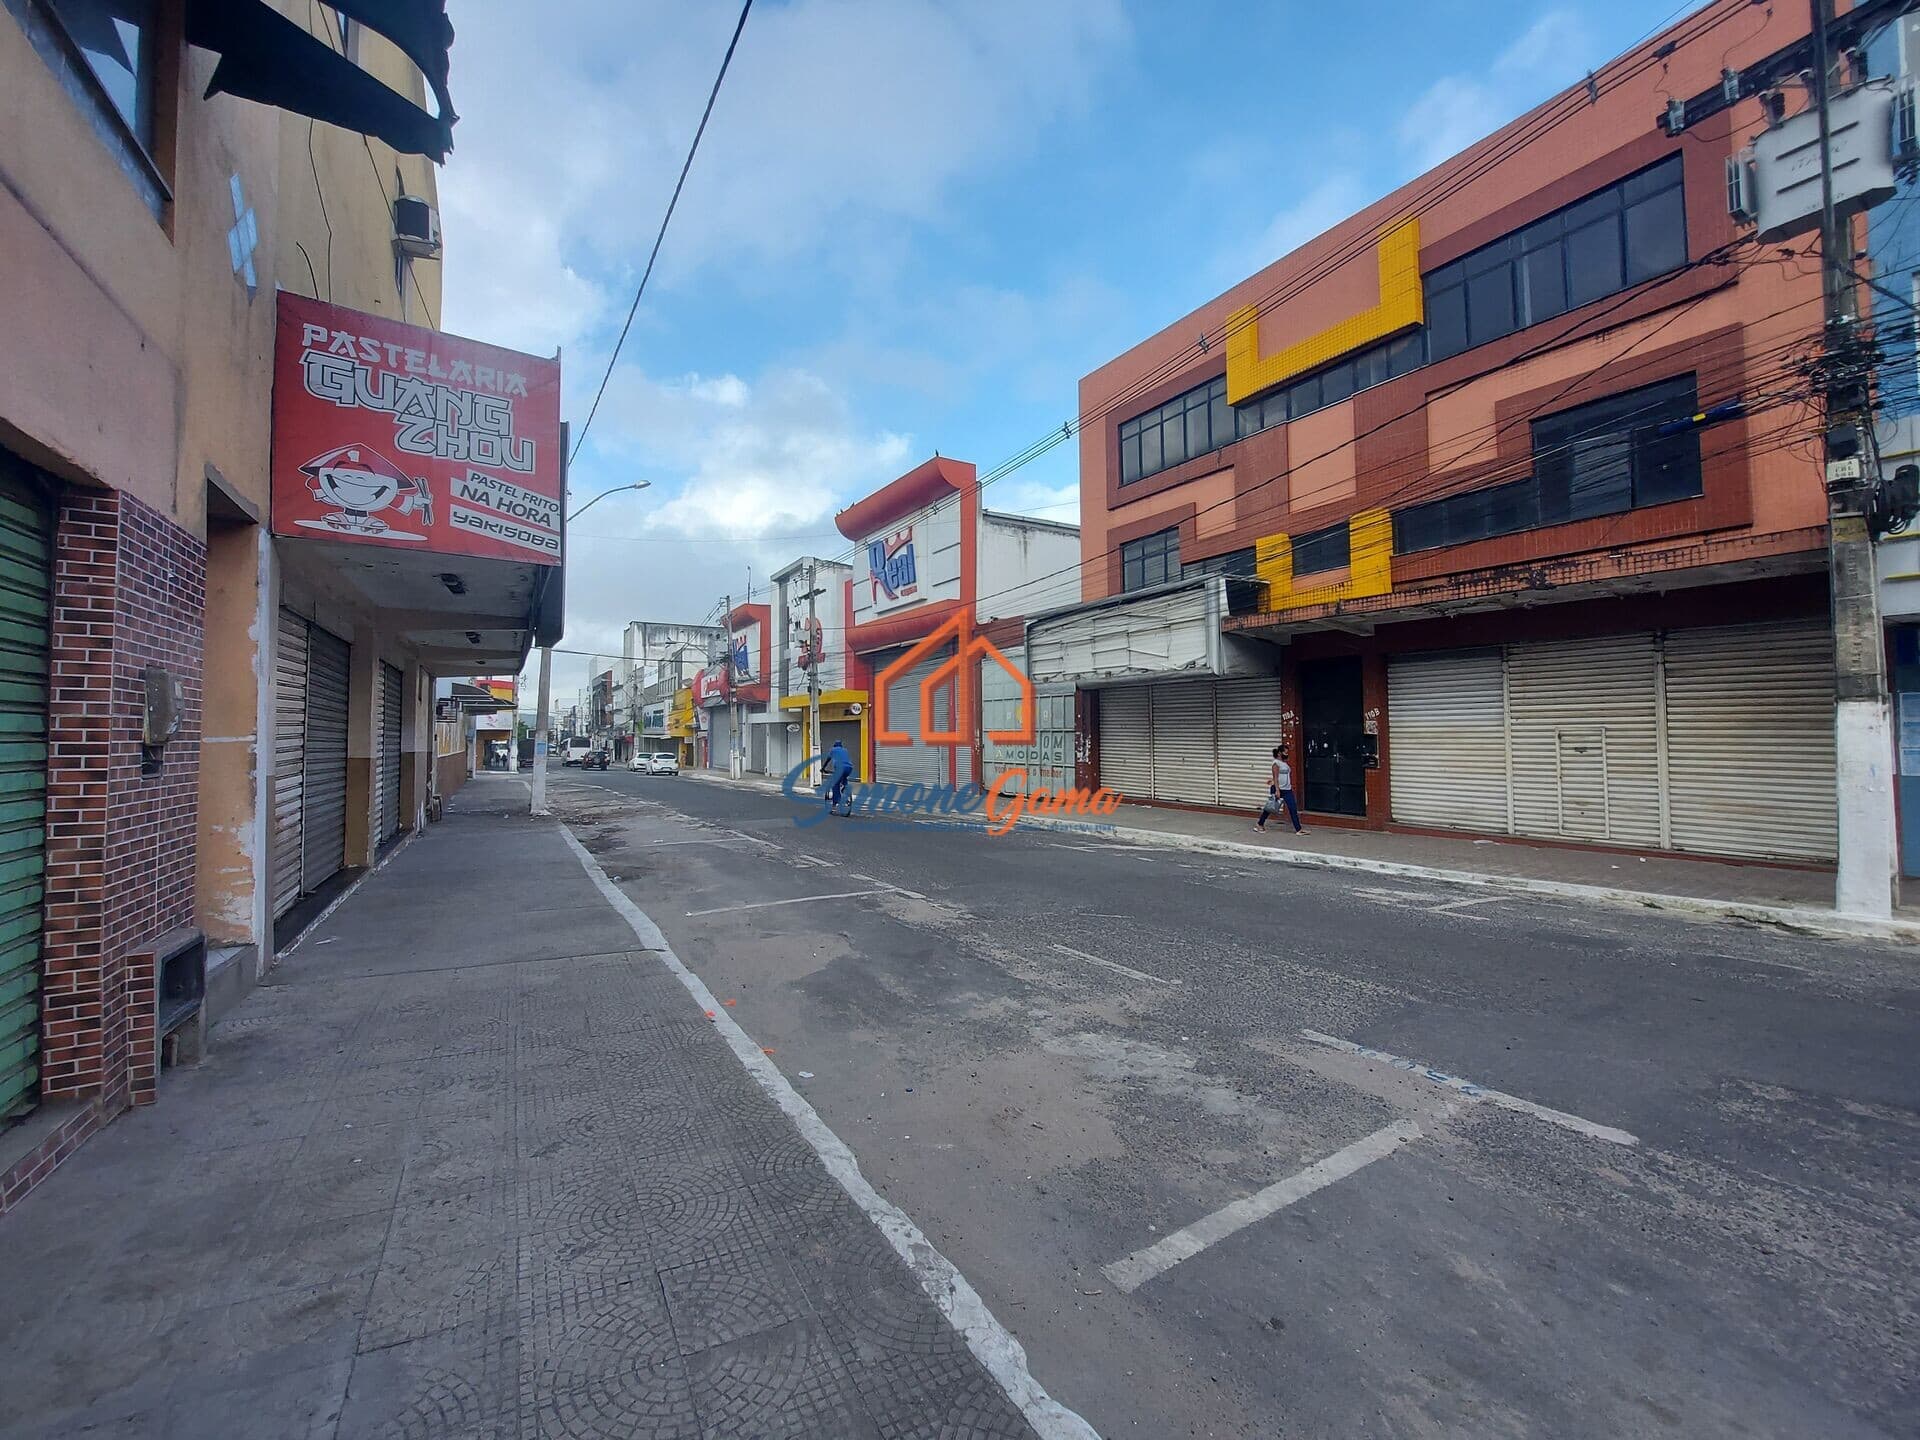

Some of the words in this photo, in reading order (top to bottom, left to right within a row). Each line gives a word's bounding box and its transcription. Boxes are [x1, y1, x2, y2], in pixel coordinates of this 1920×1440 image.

[302, 323, 528, 397] PASTELARIA
[301, 350, 513, 438] GUANG
[395, 412, 535, 474] ZHOU
[460, 484, 491, 506] NA
[497, 498, 551, 527] HORA
[470, 473, 518, 498] PASTEL
[868, 540, 917, 600] Real
[1006, 751, 1063, 761] MODAS
